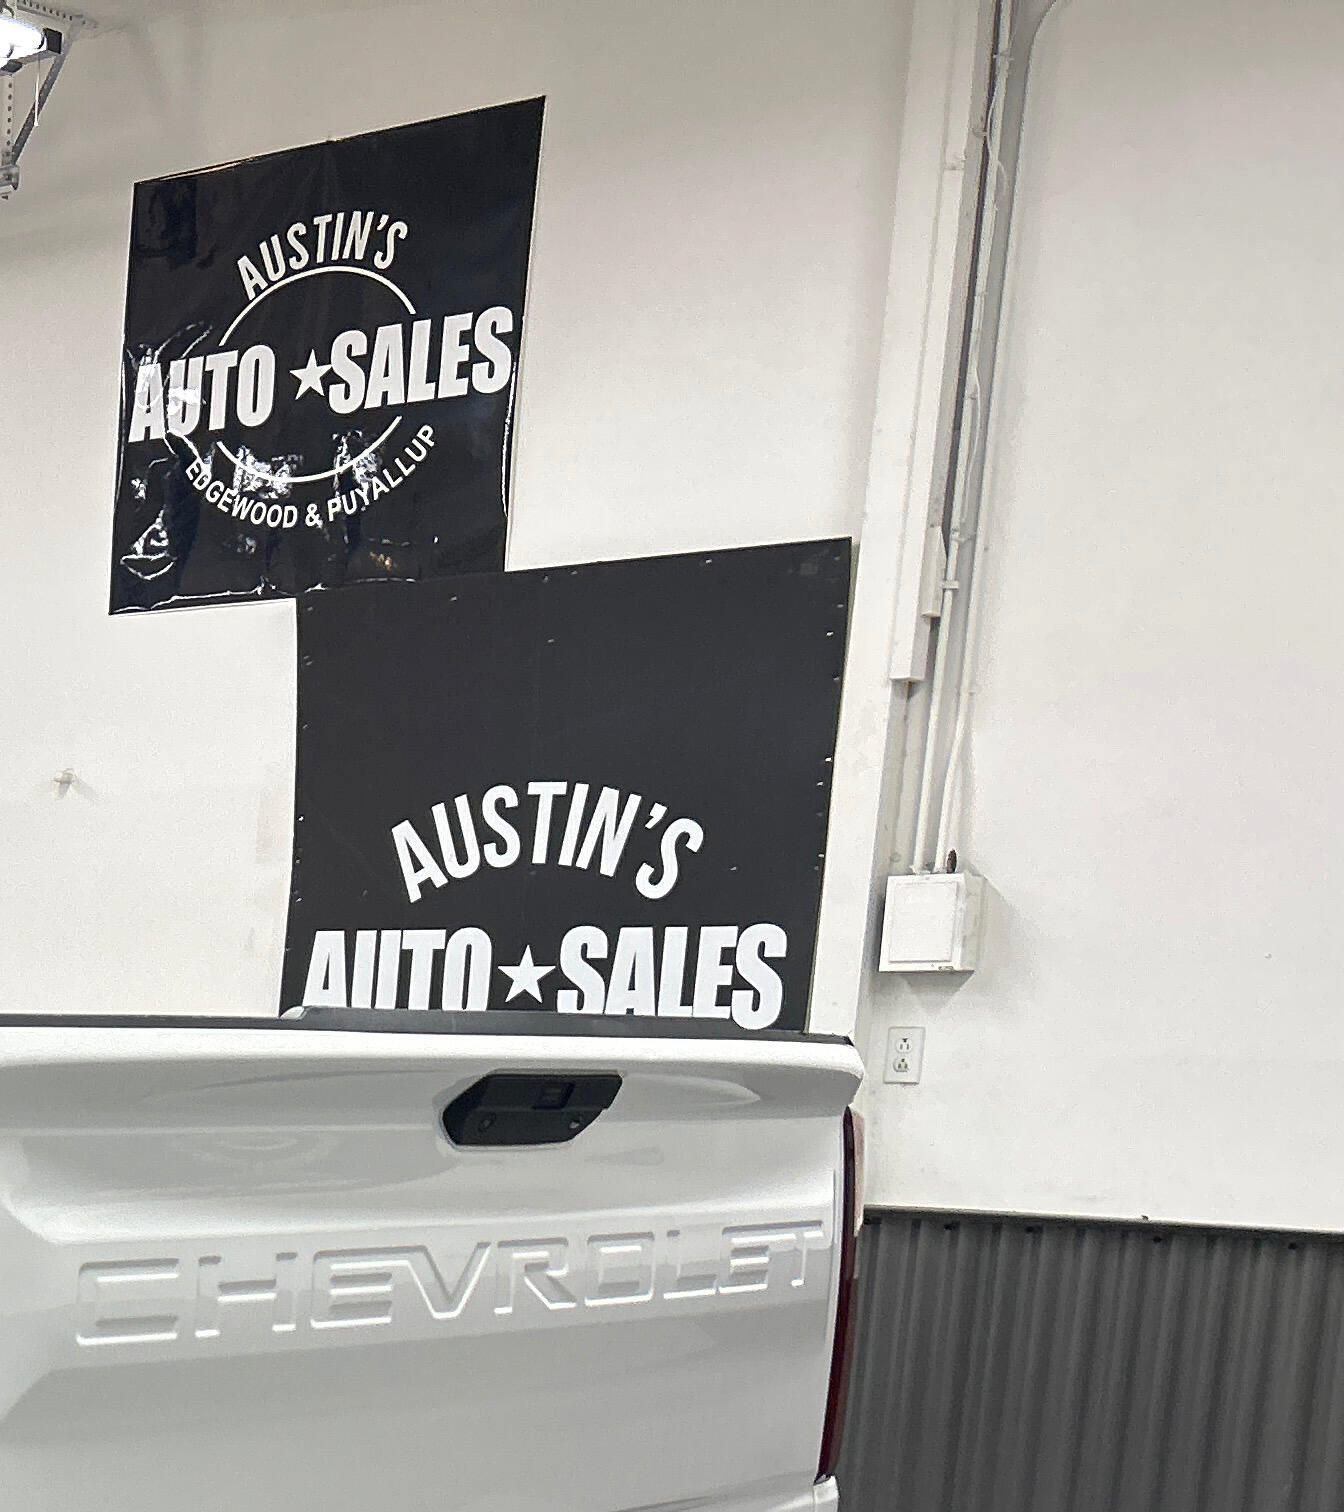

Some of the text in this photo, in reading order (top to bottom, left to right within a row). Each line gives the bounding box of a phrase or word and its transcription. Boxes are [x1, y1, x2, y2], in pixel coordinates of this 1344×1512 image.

[237, 211, 408, 300] AUSTIN'S
[128, 306, 514, 443] AUTO SALES
[185, 424, 439, 528] EDGEWOOD & PUYALLUP
[391, 780, 705, 903] AUSTIN'S
[303, 923, 788, 1031] AUTO SALES
[75, 1219, 825, 1347] CHEVROLET
